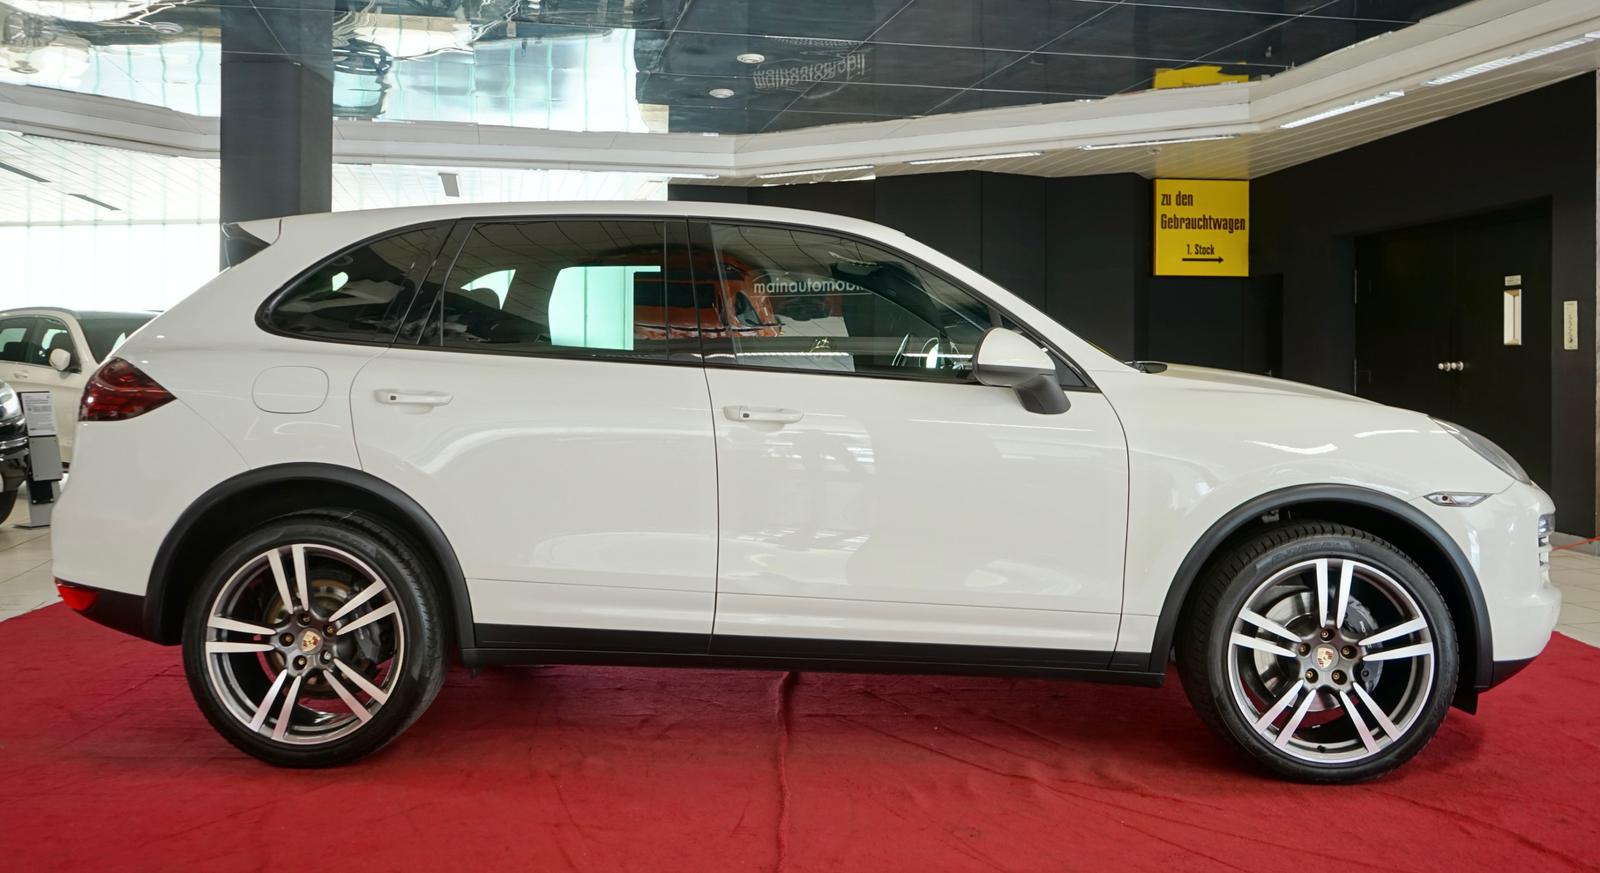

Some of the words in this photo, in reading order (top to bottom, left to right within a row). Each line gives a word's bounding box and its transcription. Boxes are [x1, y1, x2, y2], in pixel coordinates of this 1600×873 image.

[1160, 193, 1172, 207] zu
[1175, 189, 1194, 207] den
[1160, 213, 1246, 234] Gebrauchtwagen
[1186, 243, 1193, 255] 1.
[1194, 243, 1215, 255] Stock
[753, 277, 864, 294] mainautomob
